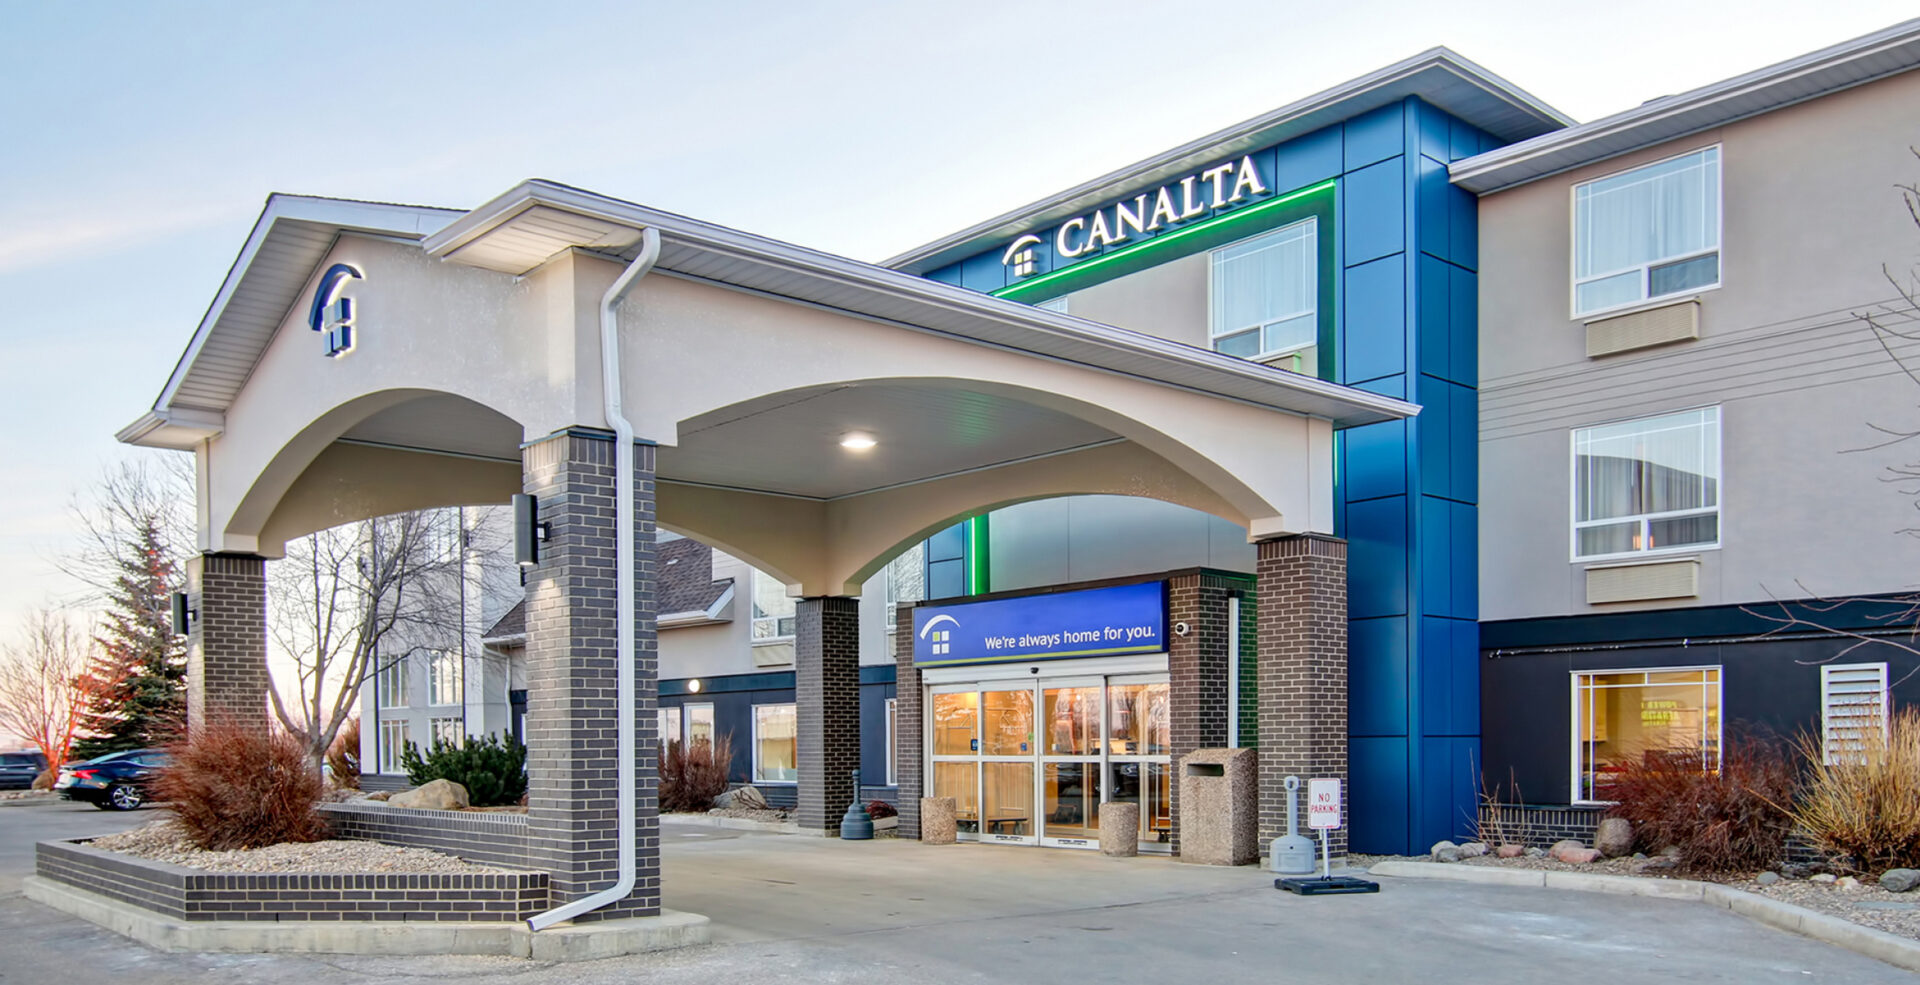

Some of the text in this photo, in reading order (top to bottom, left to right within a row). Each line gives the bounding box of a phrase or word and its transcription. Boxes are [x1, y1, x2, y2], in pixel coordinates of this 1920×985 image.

[1056, 154, 1267, 258] CANALTA
[985, 625, 1156, 650] We're always home for you.
[1318, 793, 1330, 802] NO
[1311, 804, 1337, 814] PARKING
